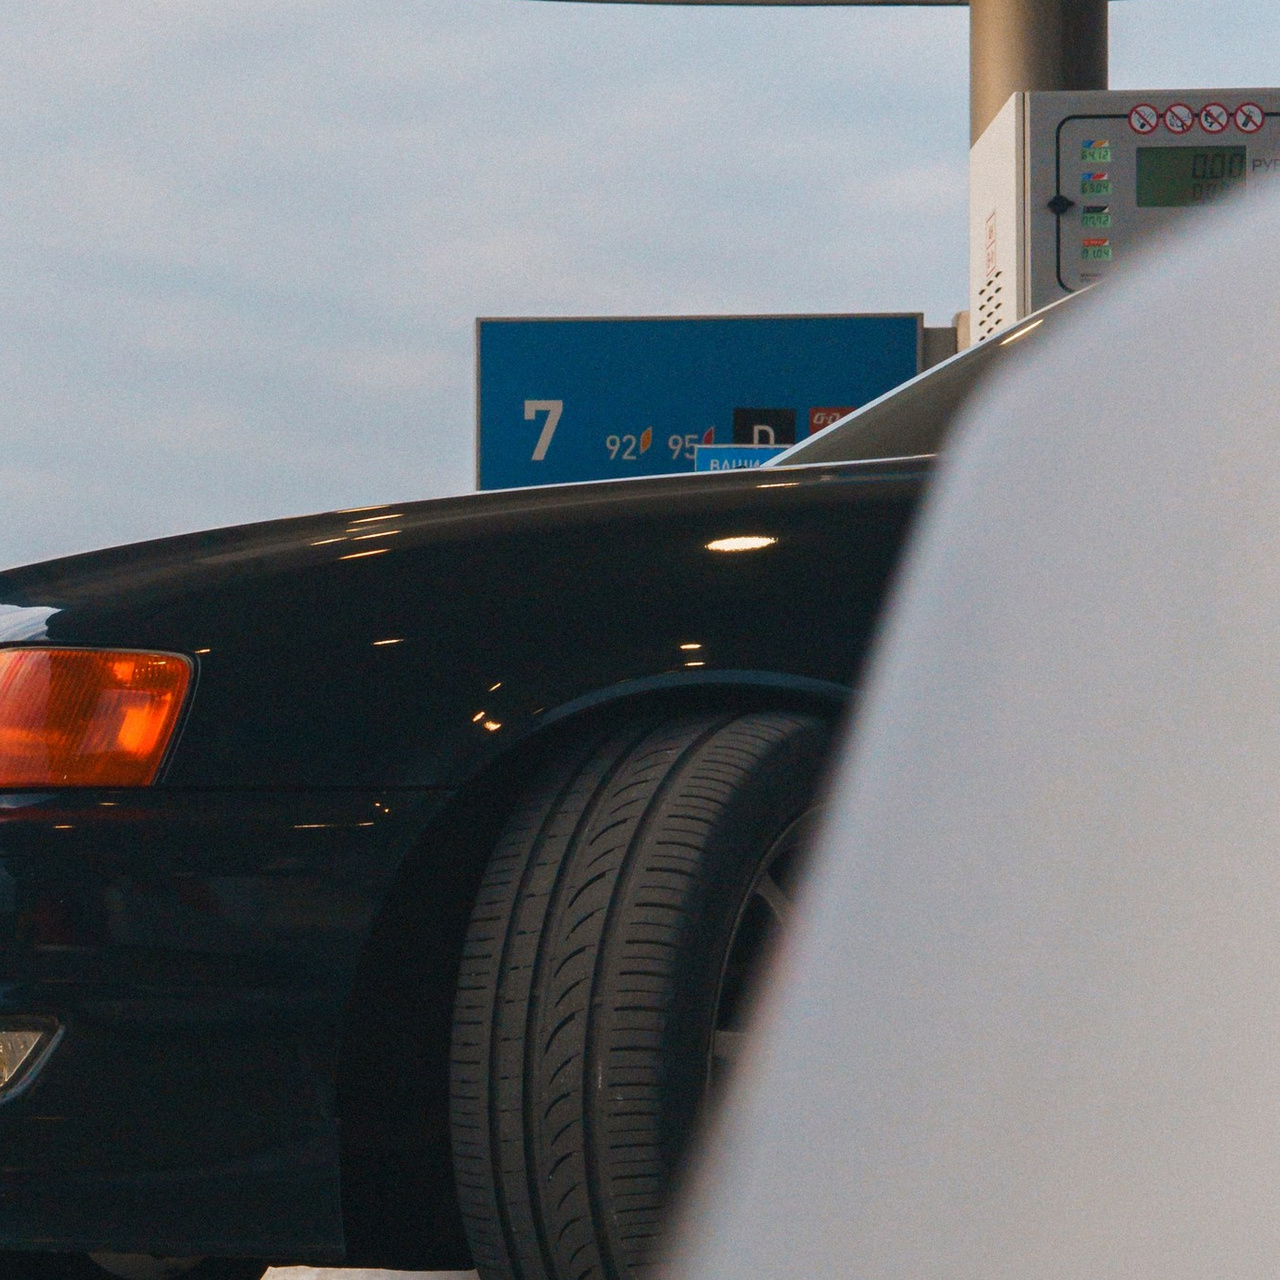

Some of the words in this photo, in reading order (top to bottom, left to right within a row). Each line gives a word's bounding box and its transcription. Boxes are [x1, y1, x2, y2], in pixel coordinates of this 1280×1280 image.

[523, 399, 564, 461] 7
[606, 435, 638, 461] 92
[668, 434, 698, 460] 95
